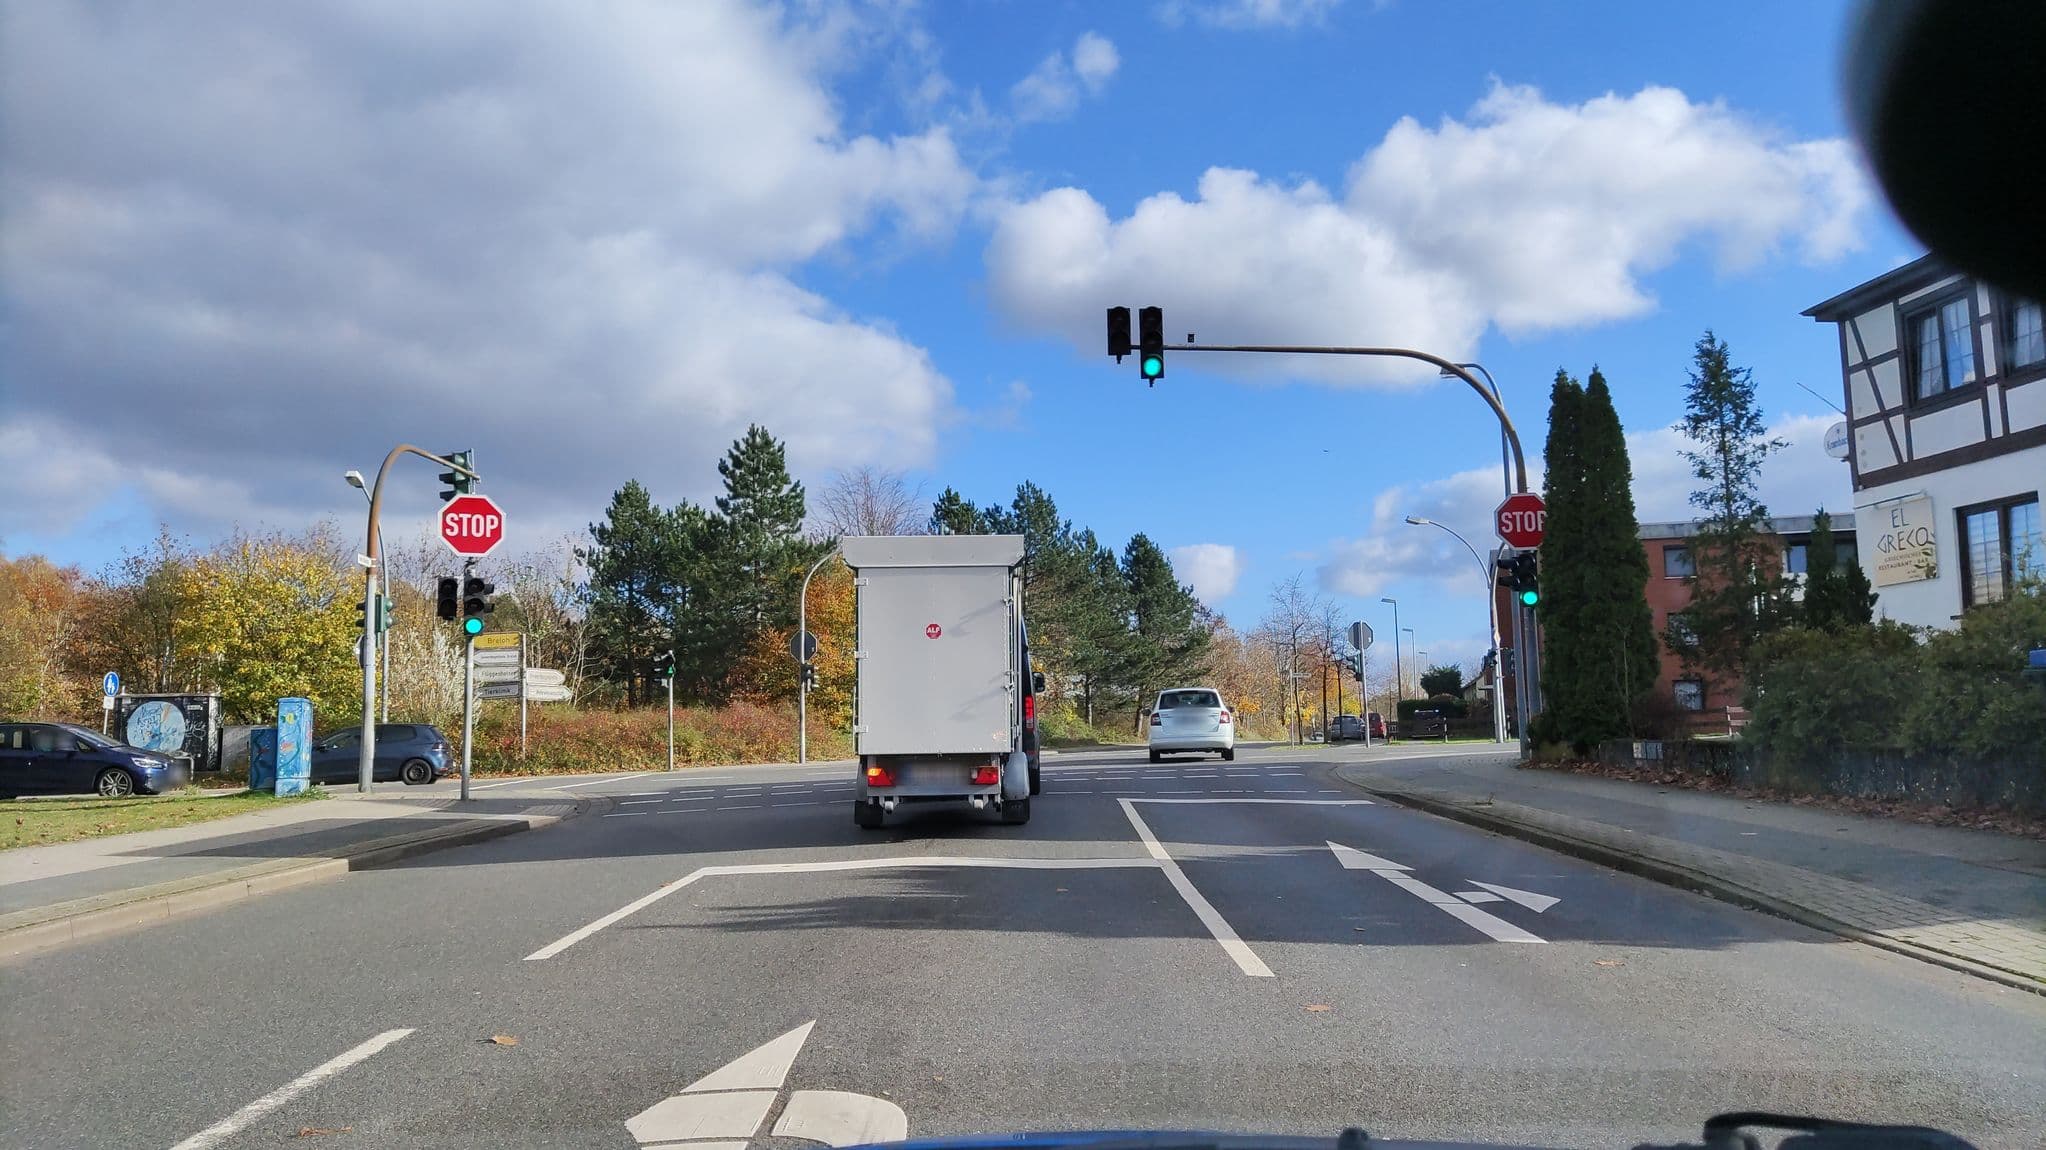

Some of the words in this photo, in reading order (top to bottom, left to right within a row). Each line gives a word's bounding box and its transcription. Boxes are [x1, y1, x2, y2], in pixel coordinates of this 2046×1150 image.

[445, 512, 499, 538] STOP
[1891, 508, 1910, 528] EL
[1877, 527, 1929, 553] GRECO
